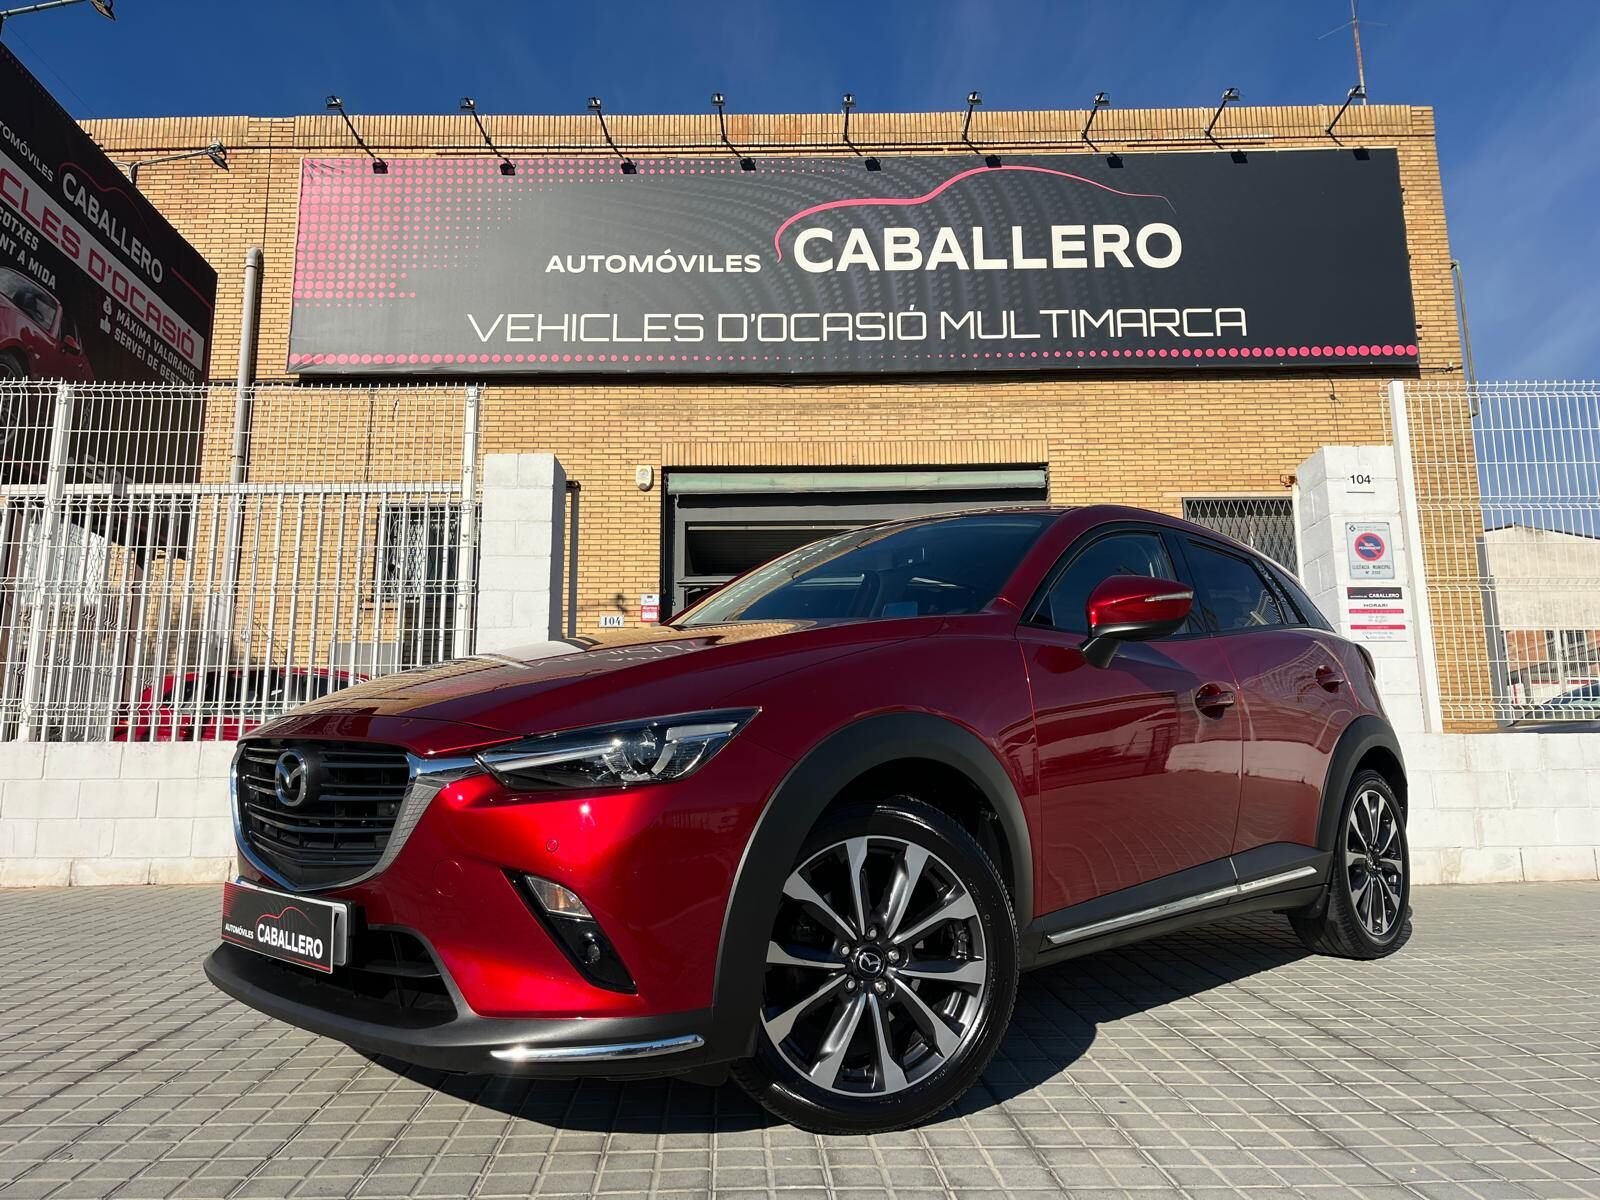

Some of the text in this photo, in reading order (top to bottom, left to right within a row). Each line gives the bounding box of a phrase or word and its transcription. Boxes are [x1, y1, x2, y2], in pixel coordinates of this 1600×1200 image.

[62, 172, 164, 283] CABALLERO
[545, 222, 1183, 274] AUTOMÓVILES CABALLERO
[17, 249, 26, 265] A
[28, 256, 56, 290] MIDA
[88, 247, 196, 360] D'OCASIÓ
[466, 304, 1248, 343] VEHICLES D'OCASIÓ MULTIMARCA
[114, 327, 146, 362] SERVEI
[147, 354, 159, 370] DE
[116, 308, 195, 382] MÀXIMA VALORACIÓ
[1349, 474, 1371, 485] 104
[604, 616, 621, 626] 104
[224, 923, 323, 959] AUTOMÓVILES CABALLERO
